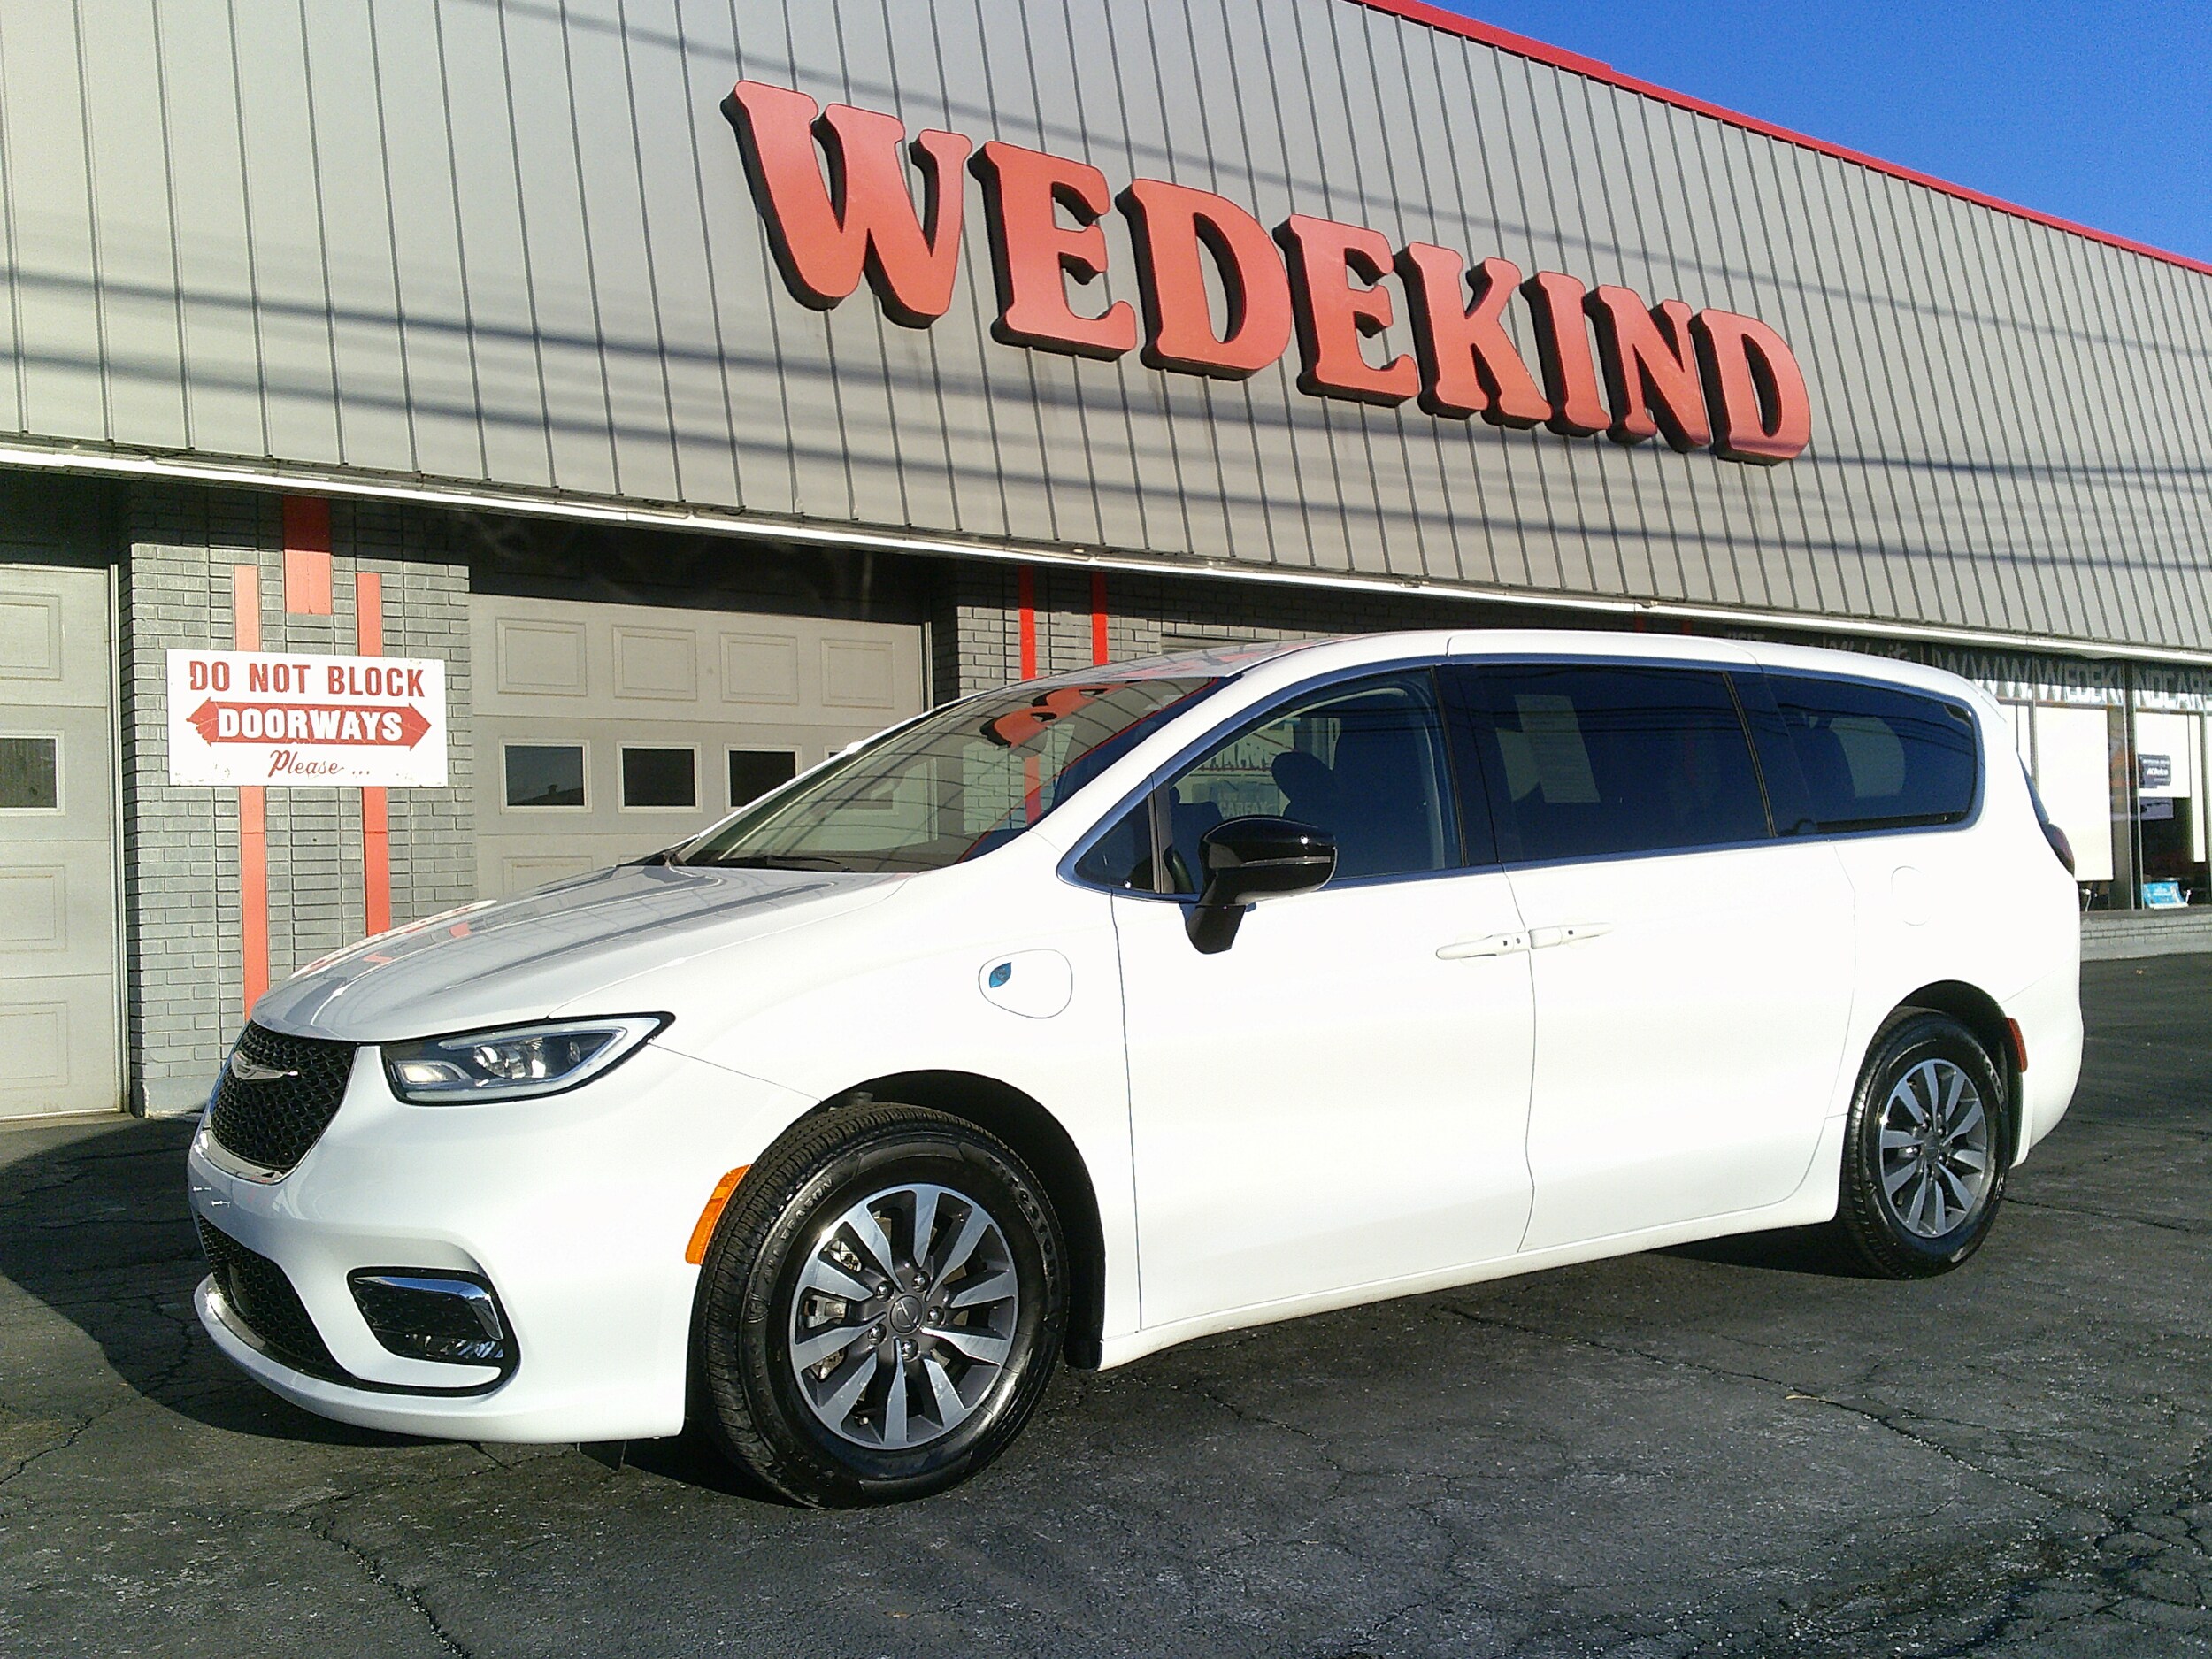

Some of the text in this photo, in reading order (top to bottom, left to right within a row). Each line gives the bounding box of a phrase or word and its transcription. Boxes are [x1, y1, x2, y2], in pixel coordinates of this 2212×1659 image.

[722, 80, 1811, 466] WEDEKIND
[189, 660, 426, 698] DO NOT BLOCK
[218, 707, 403, 742] DOORWAYS
[267, 749, 344, 778] Please
